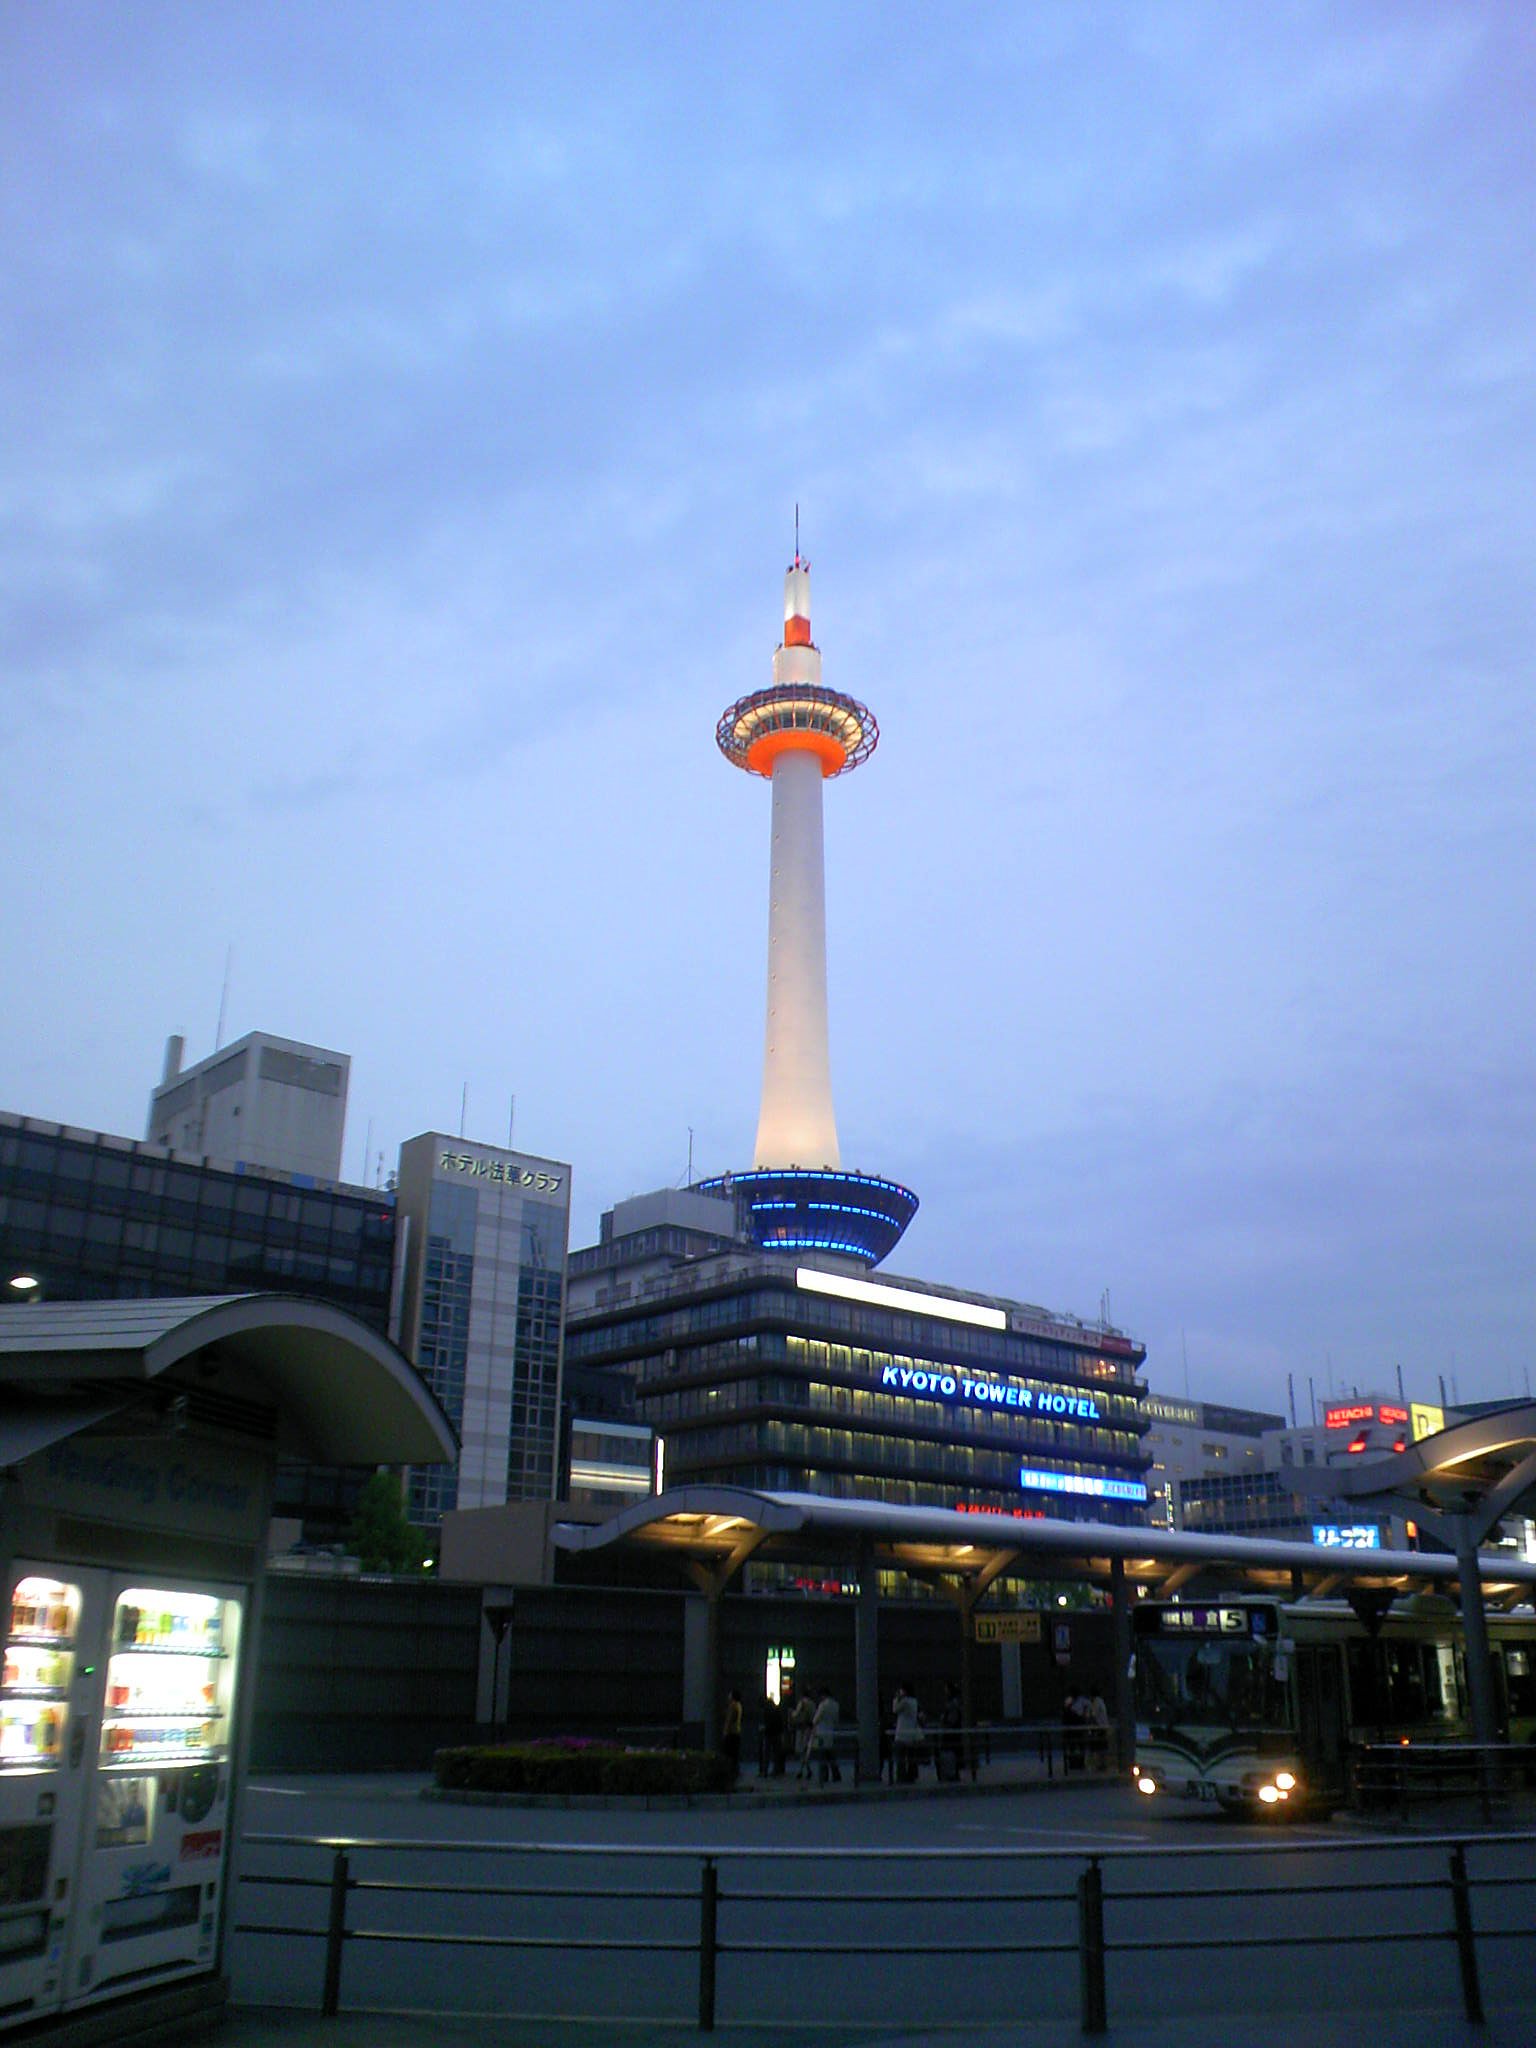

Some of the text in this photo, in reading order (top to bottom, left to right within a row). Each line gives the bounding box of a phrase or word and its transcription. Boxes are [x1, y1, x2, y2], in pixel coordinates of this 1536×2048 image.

[882, 1366, 1100, 1419] KYOTO TOWER HOTEL
[1226, 1612, 1242, 1628] 5
